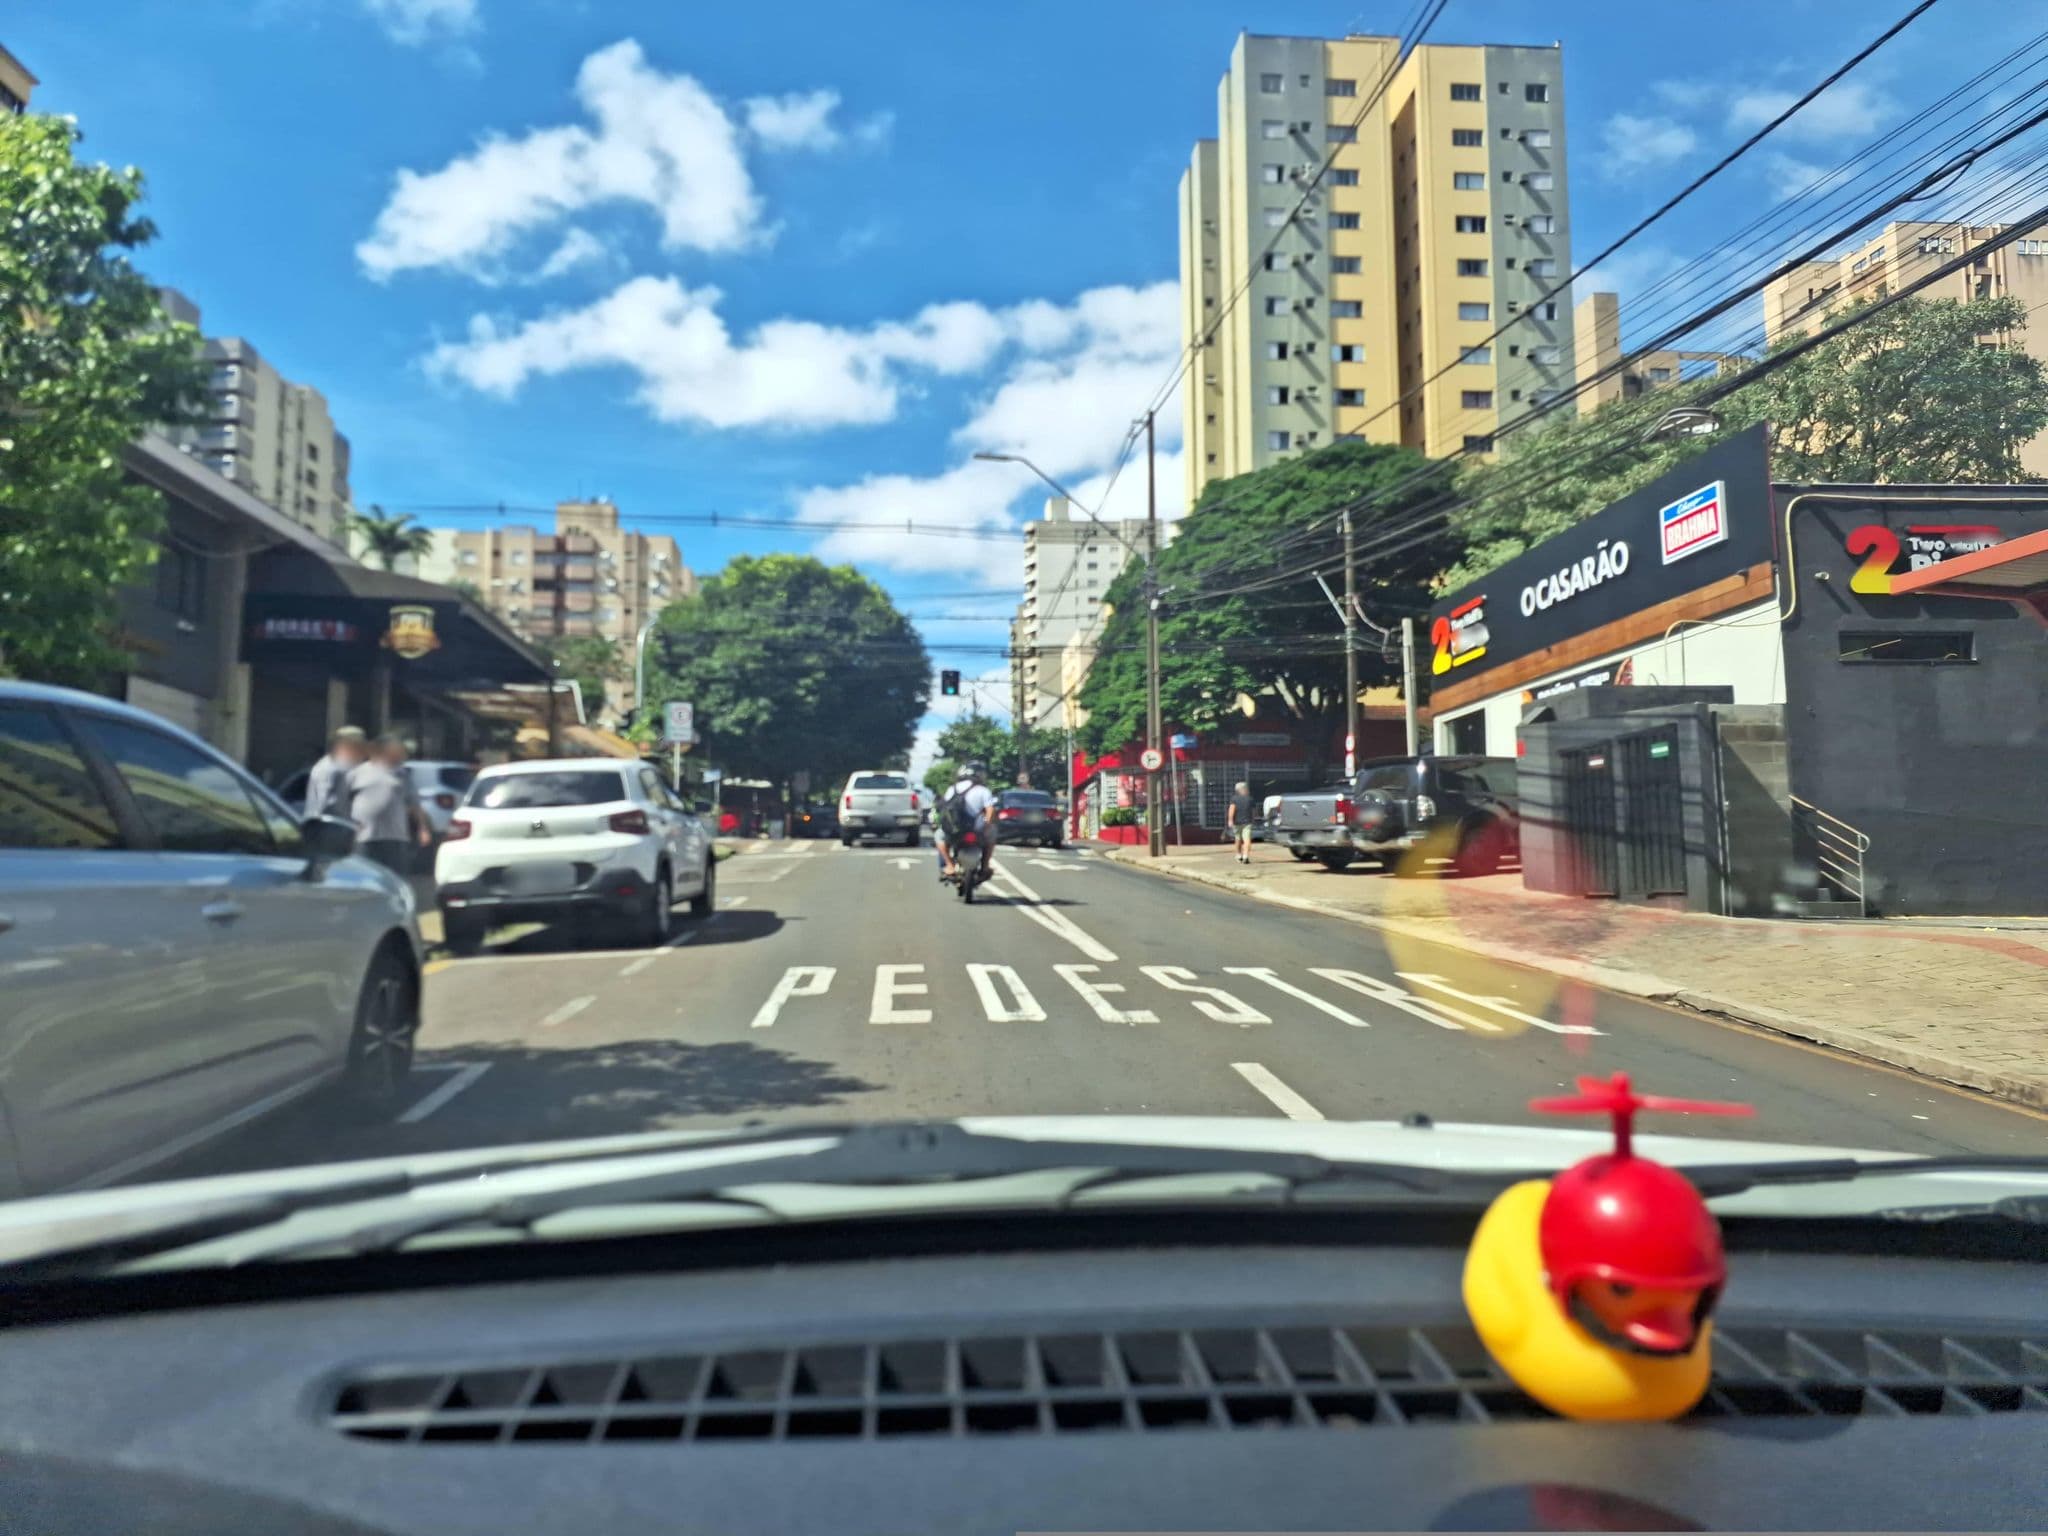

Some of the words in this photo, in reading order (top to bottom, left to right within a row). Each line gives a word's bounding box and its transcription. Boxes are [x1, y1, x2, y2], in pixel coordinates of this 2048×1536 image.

[1666, 508, 1717, 554] BRAHMA
[1846, 524, 1901, 595] 2
[1906, 537, 1946, 551] Two
[751, 963, 1611, 1036] PEDESTRE
